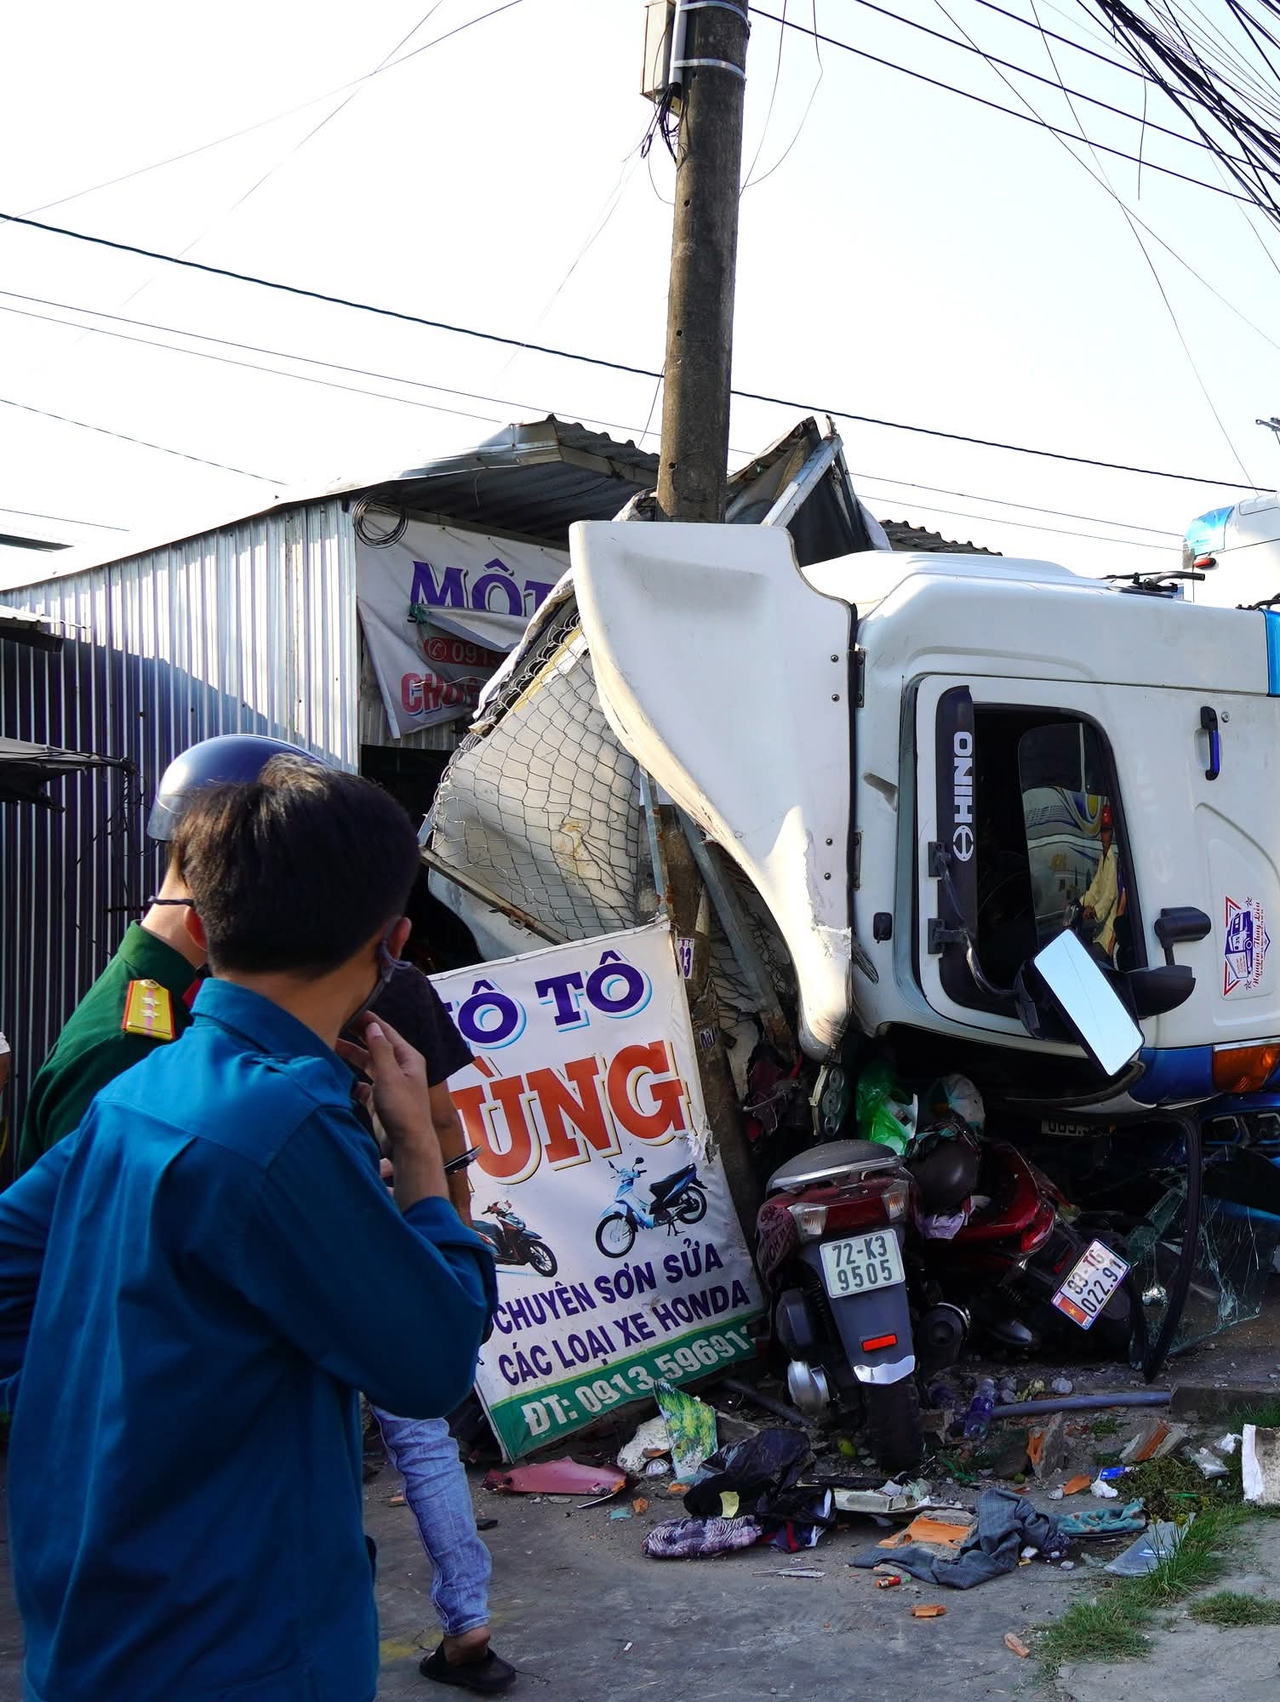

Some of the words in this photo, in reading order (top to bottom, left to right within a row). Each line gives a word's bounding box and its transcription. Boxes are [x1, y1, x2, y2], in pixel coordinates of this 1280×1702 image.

[953, 731, 973, 823] HINO
[535, 950, 652, 1032] TÔ
[450, 1040, 690, 1184] ÙNG
[493, 1282, 597, 1334] CHUYÊN
[594, 1261, 657, 1304] SƠN
[663, 1238, 724, 1284] SỬA
[832, 1236, 888, 1268] 72-K3
[837, 1259, 893, 1291] 9505
[1081, 1258, 1125, 1313] 022.91
[499, 1343, 553, 1386] CÁC
[552, 1325, 617, 1370] LOẠI
[613, 1312, 655, 1348] XE
[652, 1279, 751, 1333] HONDA
[521, 1395, 578, 1437] ĐT:
